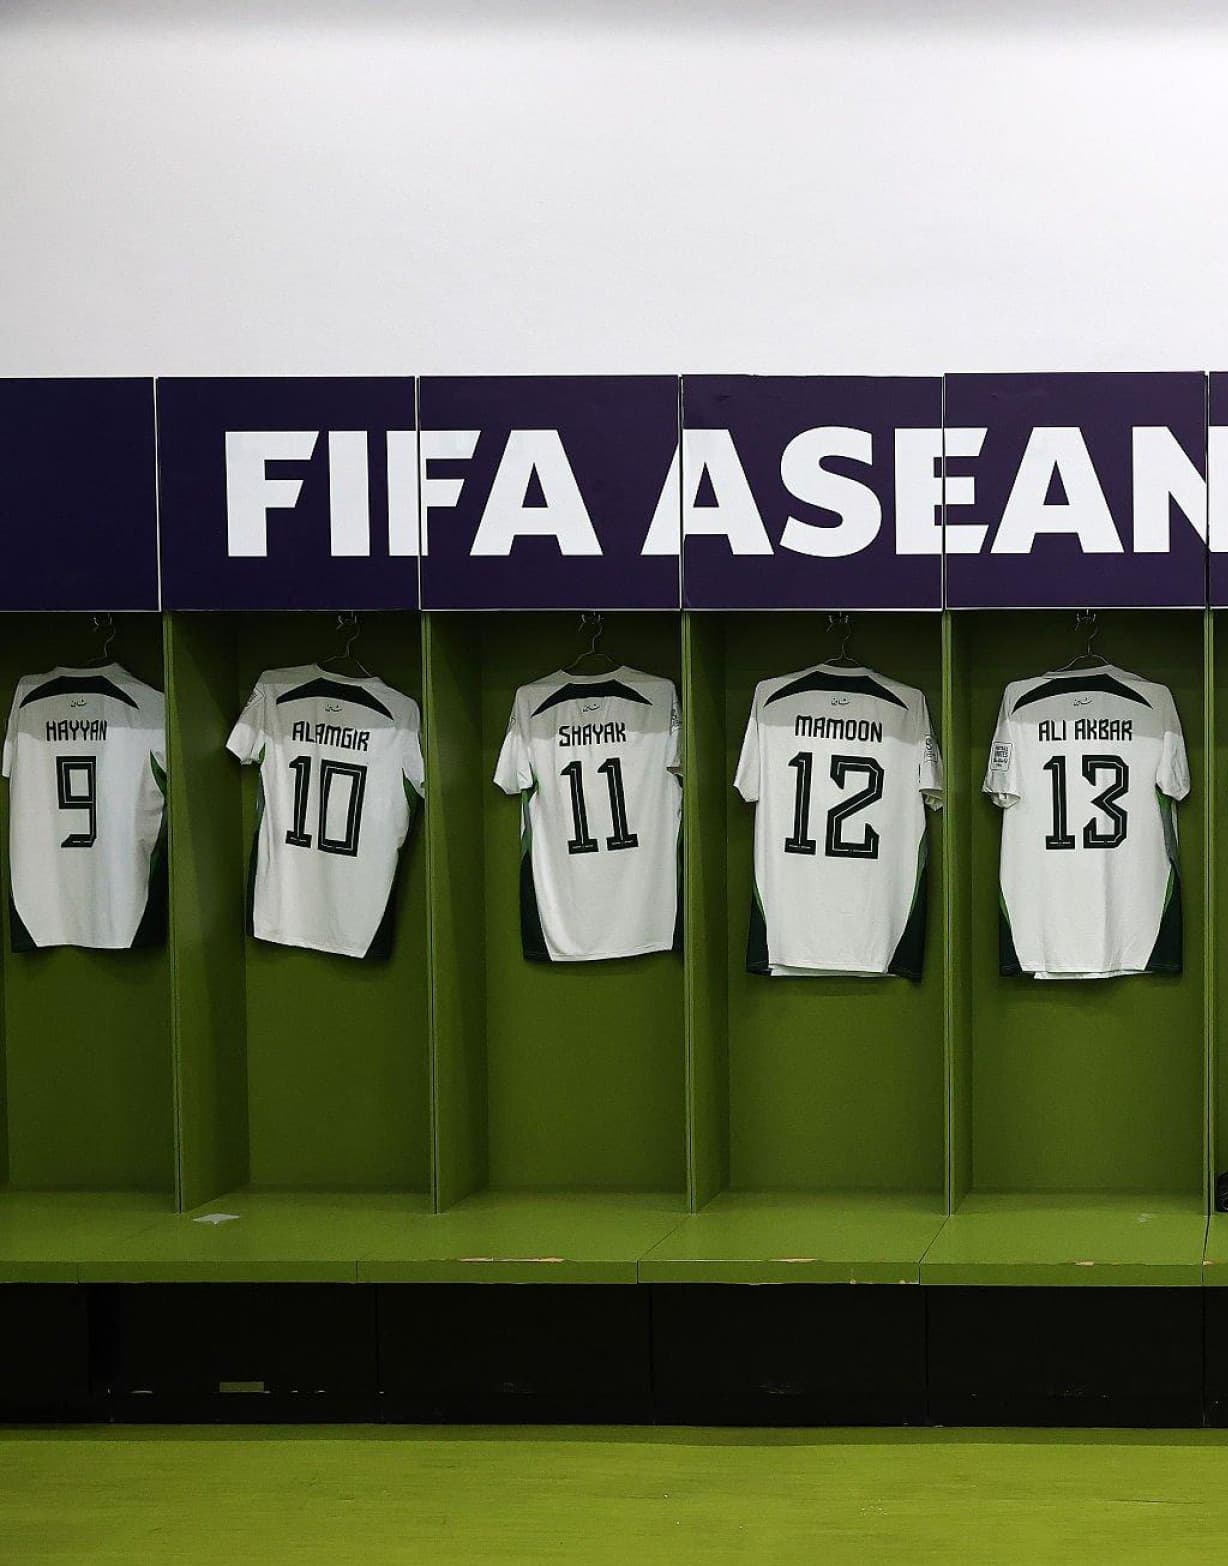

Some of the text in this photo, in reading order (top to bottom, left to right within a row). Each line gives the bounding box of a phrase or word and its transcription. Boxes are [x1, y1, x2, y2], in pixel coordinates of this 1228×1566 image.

[224, 429, 604, 558] FIFA
[45, 719, 108, 742] HAYYAN
[291, 720, 371, 752] ALAMGIR
[558, 721, 627, 747] SHAYAK
[794, 714, 883, 743] MAMOON
[1038, 718, 1133, 742] ALI AKBAR
[55, 755, 98, 849] 9
[285, 755, 368, 858] 10
[559, 757, 639, 855] 11
[784, 751, 885, 860] 12
[1042, 754, 1130, 851] 13
